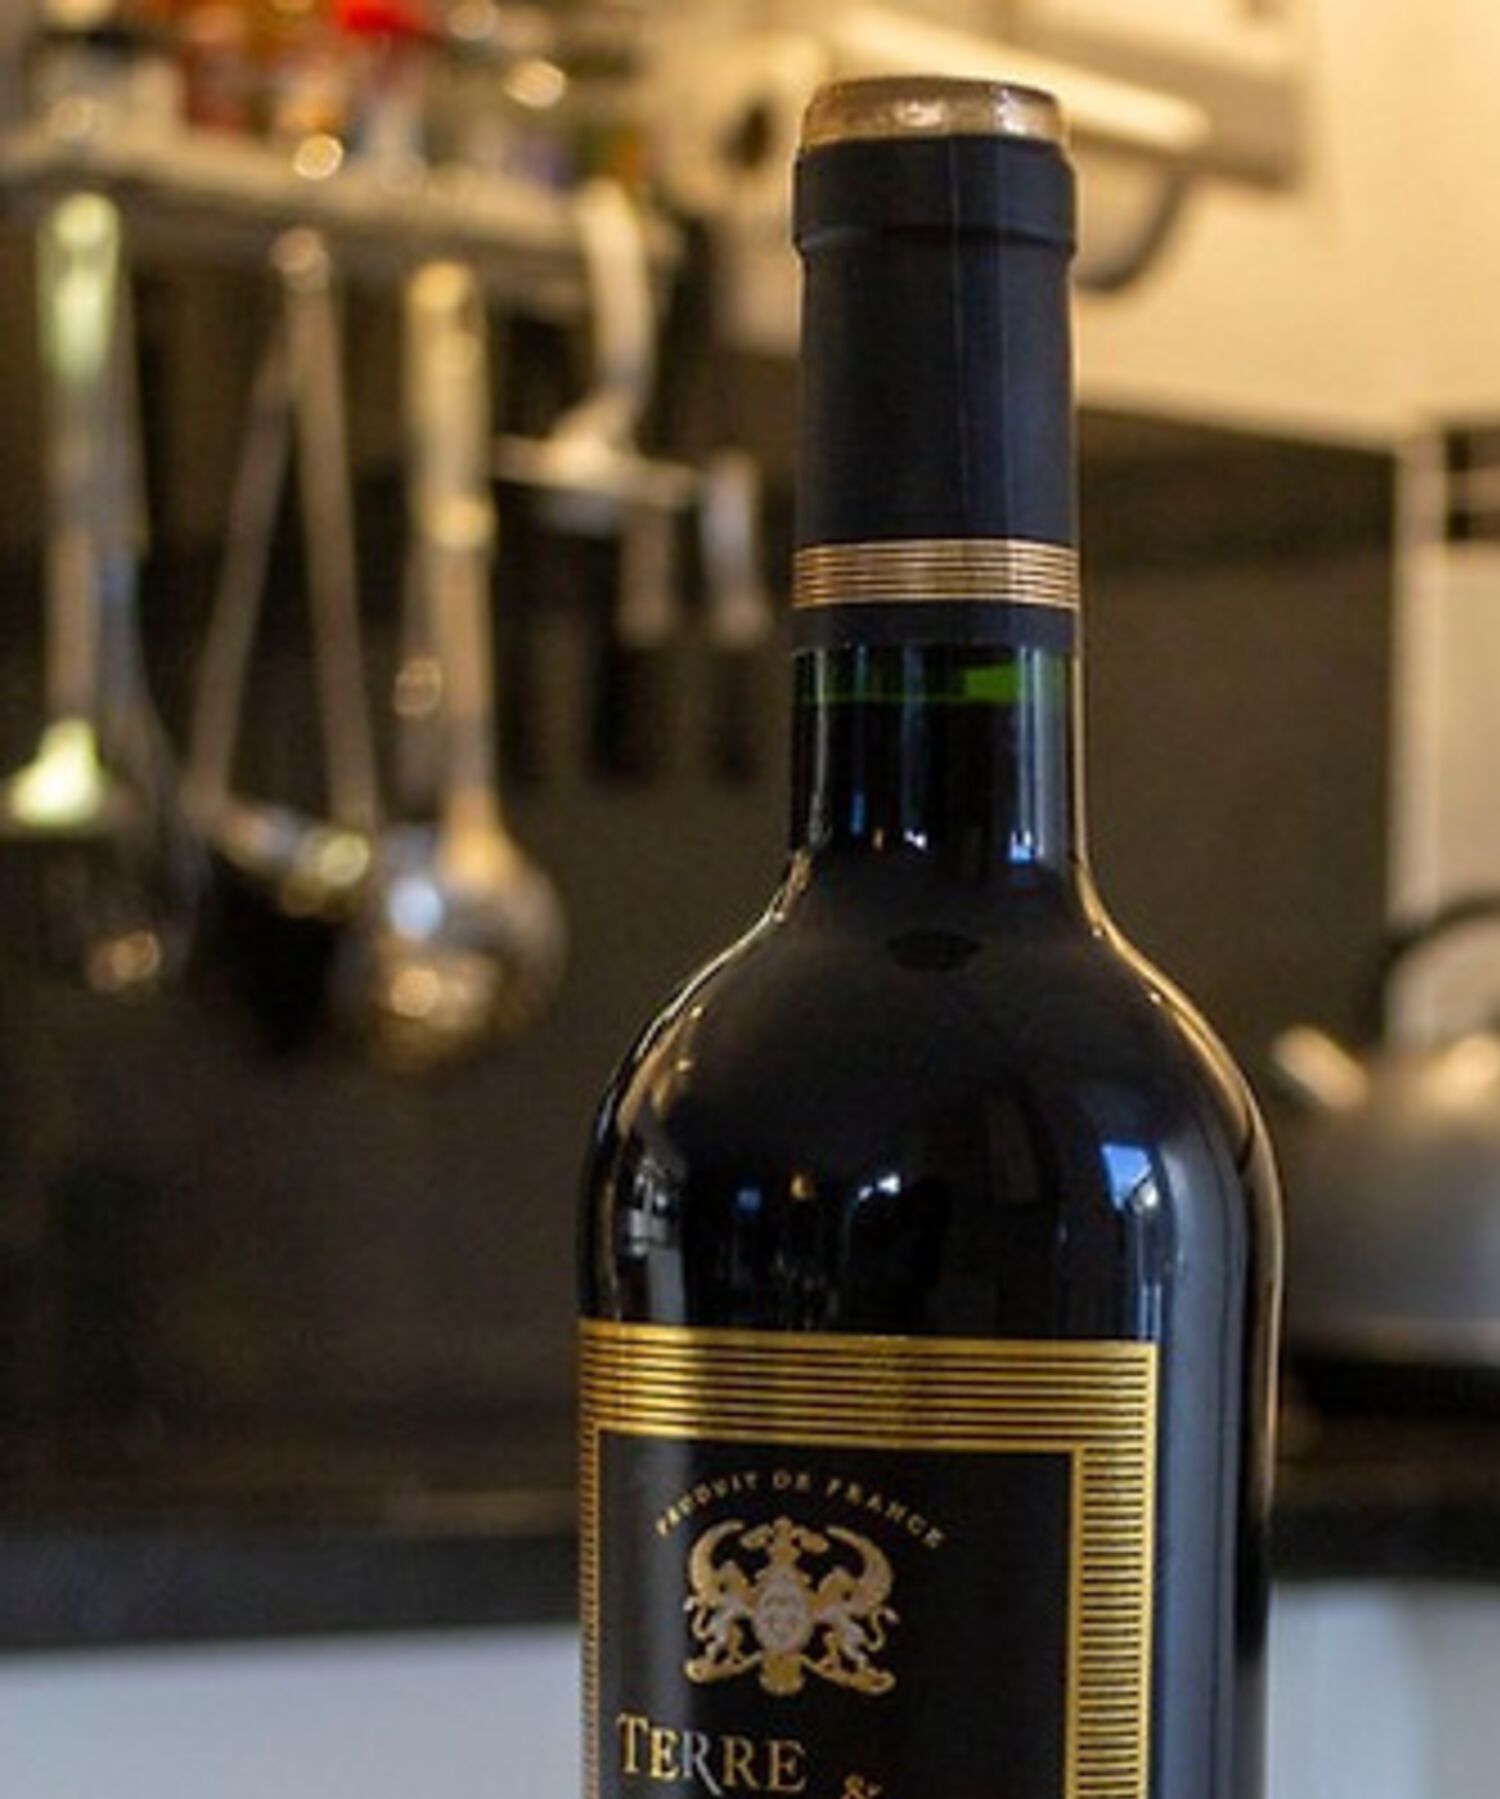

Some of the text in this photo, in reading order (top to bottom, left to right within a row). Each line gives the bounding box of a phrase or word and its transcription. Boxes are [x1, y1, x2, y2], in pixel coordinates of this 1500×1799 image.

[654, 1470, 946, 1549] PRODUIT DE FRANCE
[615, 1713, 808, 1796] TERRE
